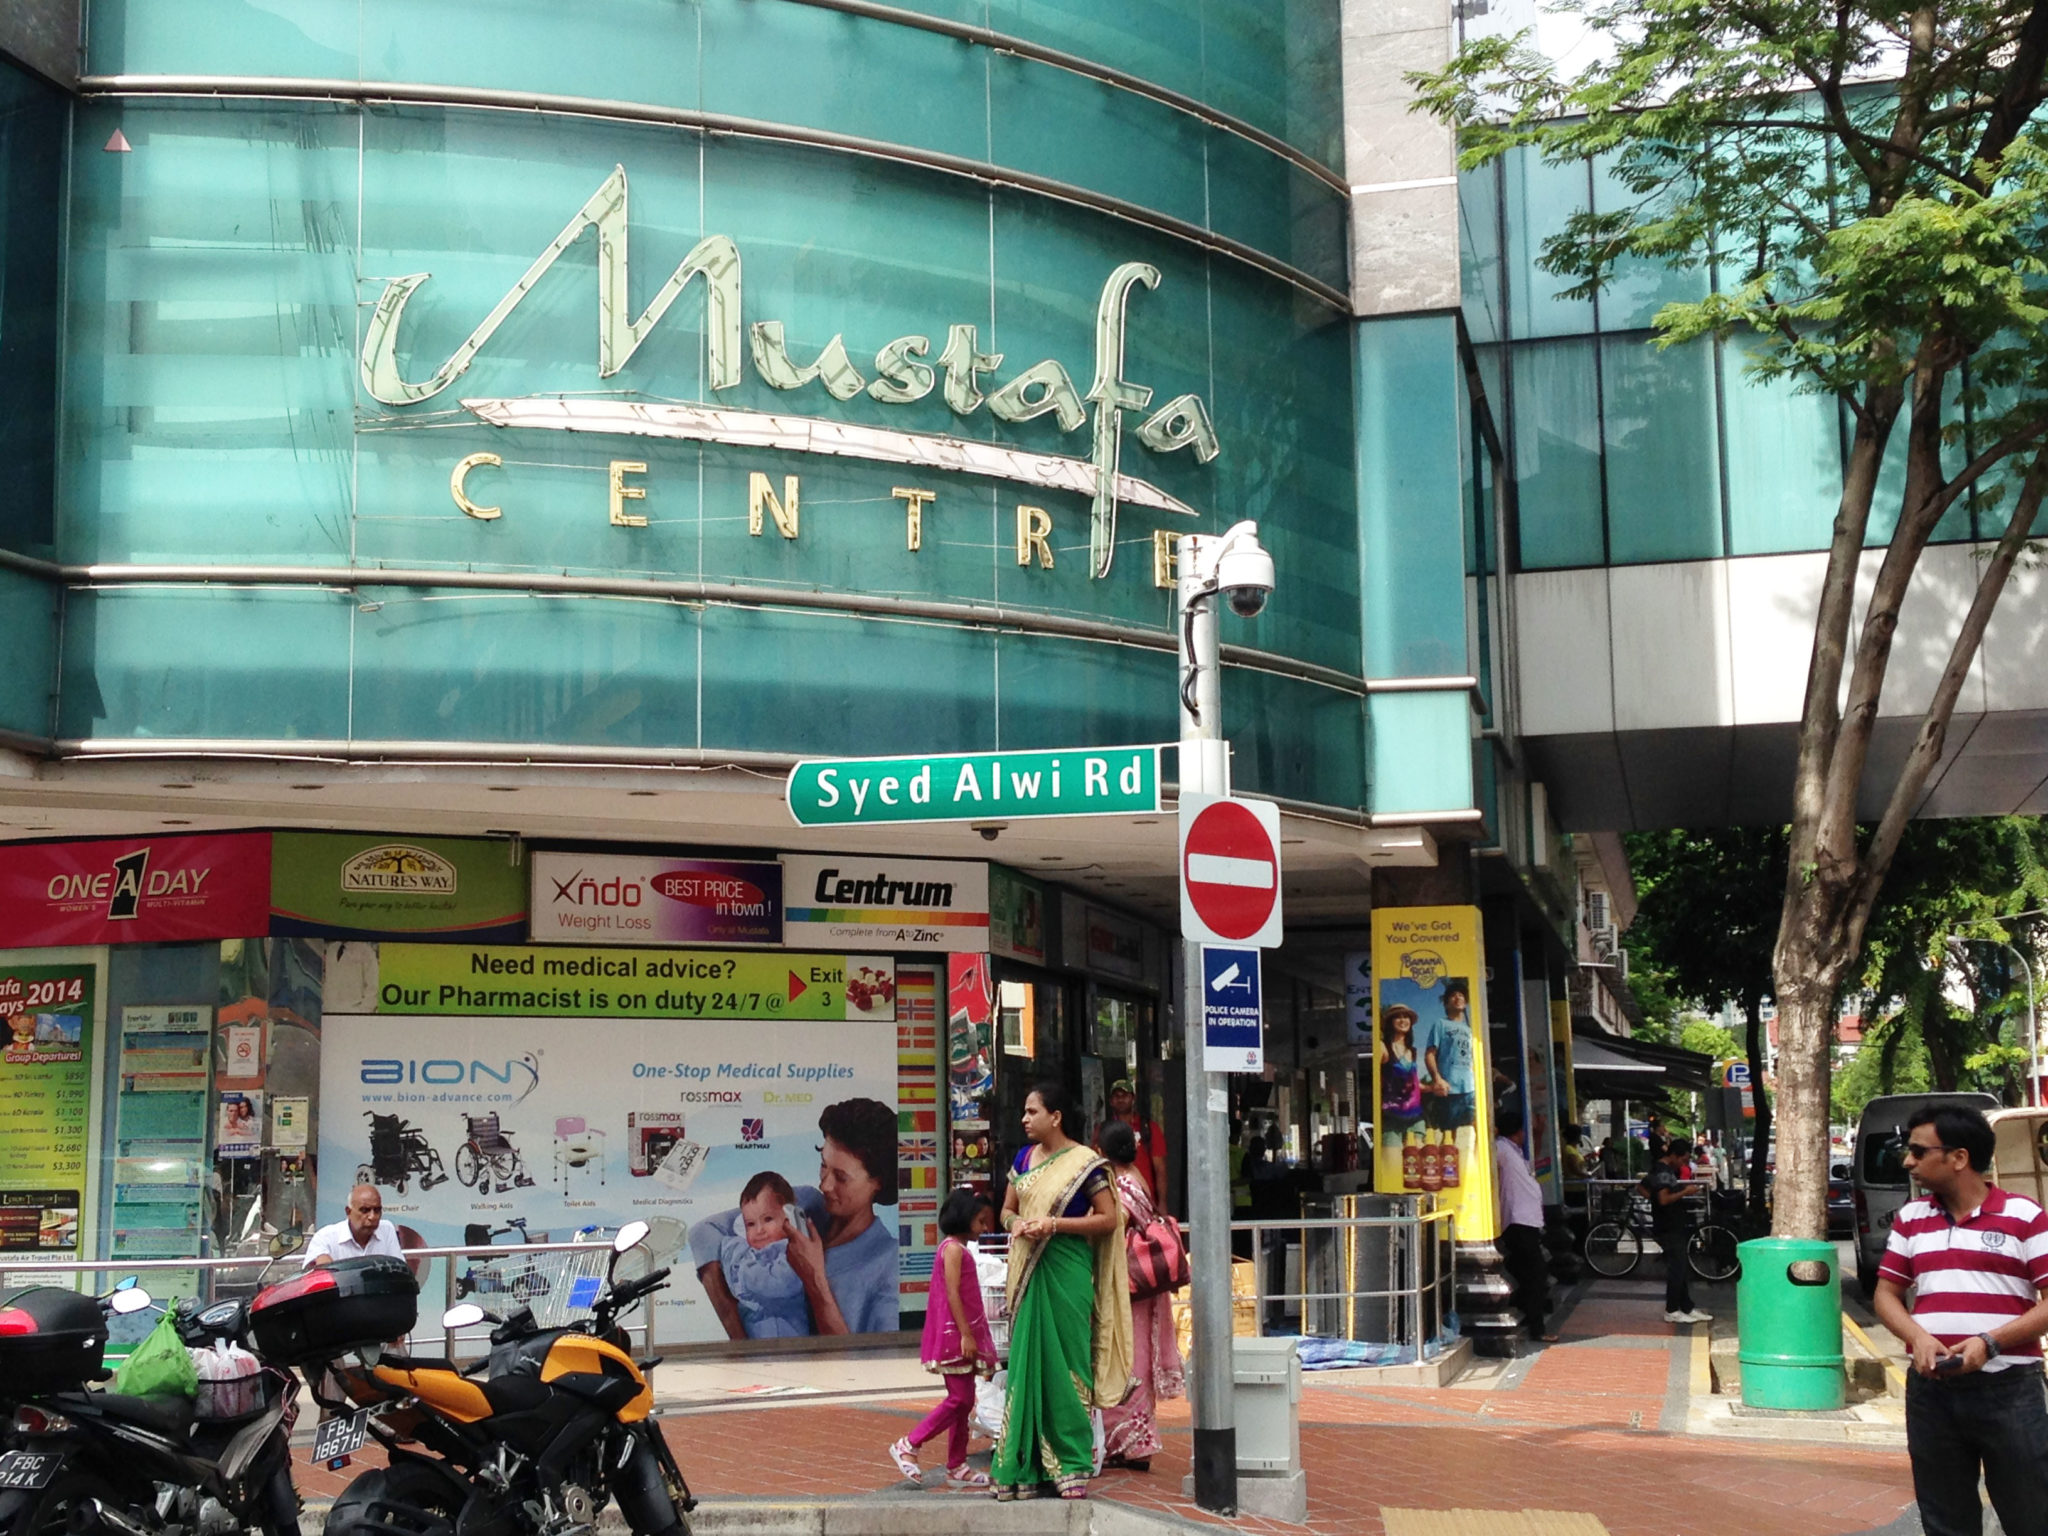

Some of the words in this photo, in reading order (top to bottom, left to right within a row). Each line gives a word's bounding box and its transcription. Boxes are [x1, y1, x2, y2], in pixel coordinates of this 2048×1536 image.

[361, 163, 1221, 579] Mustafa
[450, 452, 1178, 588] CENTRE
[817, 765, 930, 816] Syed
[953, 759, 1060, 802] Alwi
[1084, 755, 1142, 797] Rd
[47, 872, 112, 900] ONE
[115, 868, 137, 897] A
[147, 867, 210, 896] DAY
[420, 876, 450, 889] WAY
[665, 878, 700, 897] BEST
[704, 880, 744, 899] PRICE
[815, 869, 953, 907] Centrum
[716, 899, 727, 917] in
[731, 902, 764, 917] town
[559, 913, 611, 932] Weight
[616, 914, 652, 930] Loss
[1430, 920, 1453, 931] Got
[829, 925, 873, 939] Complete
[875, 928, 897, 938] from
[1385, 934, 1408, 944] You
[1409, 932, 1460, 943] Covered
[471, 953, 534, 975] Need
[543, 956, 637, 977] medical
[645, 958, 737, 979] advice?
[810, 967, 843, 983] Exit
[27, 979, 82, 1005] 2014
[382, 984, 430, 1007] Our
[438, 984, 582, 1010] Pharmacist
[589, 988, 609, 1009] is
[617, 993, 647, 1010] on
[655, 990, 706, 1015] duty
[712, 992, 760, 1012] 24/7
[765, 992, 784, 1013] @
[822, 992, 831, 1007] 3
[1205, 1005, 1228, 1015] POLICE
[1229, 1006, 1259, 1016] CAMERA
[1208, 1017, 1217, 1026] IN
[1218, 1018, 1257, 1027] OPERATION
[6, 1052, 31, 1063] Group
[32, 1050, 82, 1062] Departures!
[361, 1060, 511, 1084] BION
[632, 1063, 711, 1081] One-Stop
[717, 1063, 782, 1079] Medical
[787, 1064, 854, 1081] Supplies
[362, 1092, 513, 1102] www.bion-advance.com
[680, 1090, 742, 1102] rossmax
[639, 1112, 682, 1121] rossmax
[401, 1204, 420, 1212] Chair
[470, 1202, 497, 1210] Walking
[327, 1415, 356, 1439] FBJ
[10, 1456, 45, 1470] FBC
